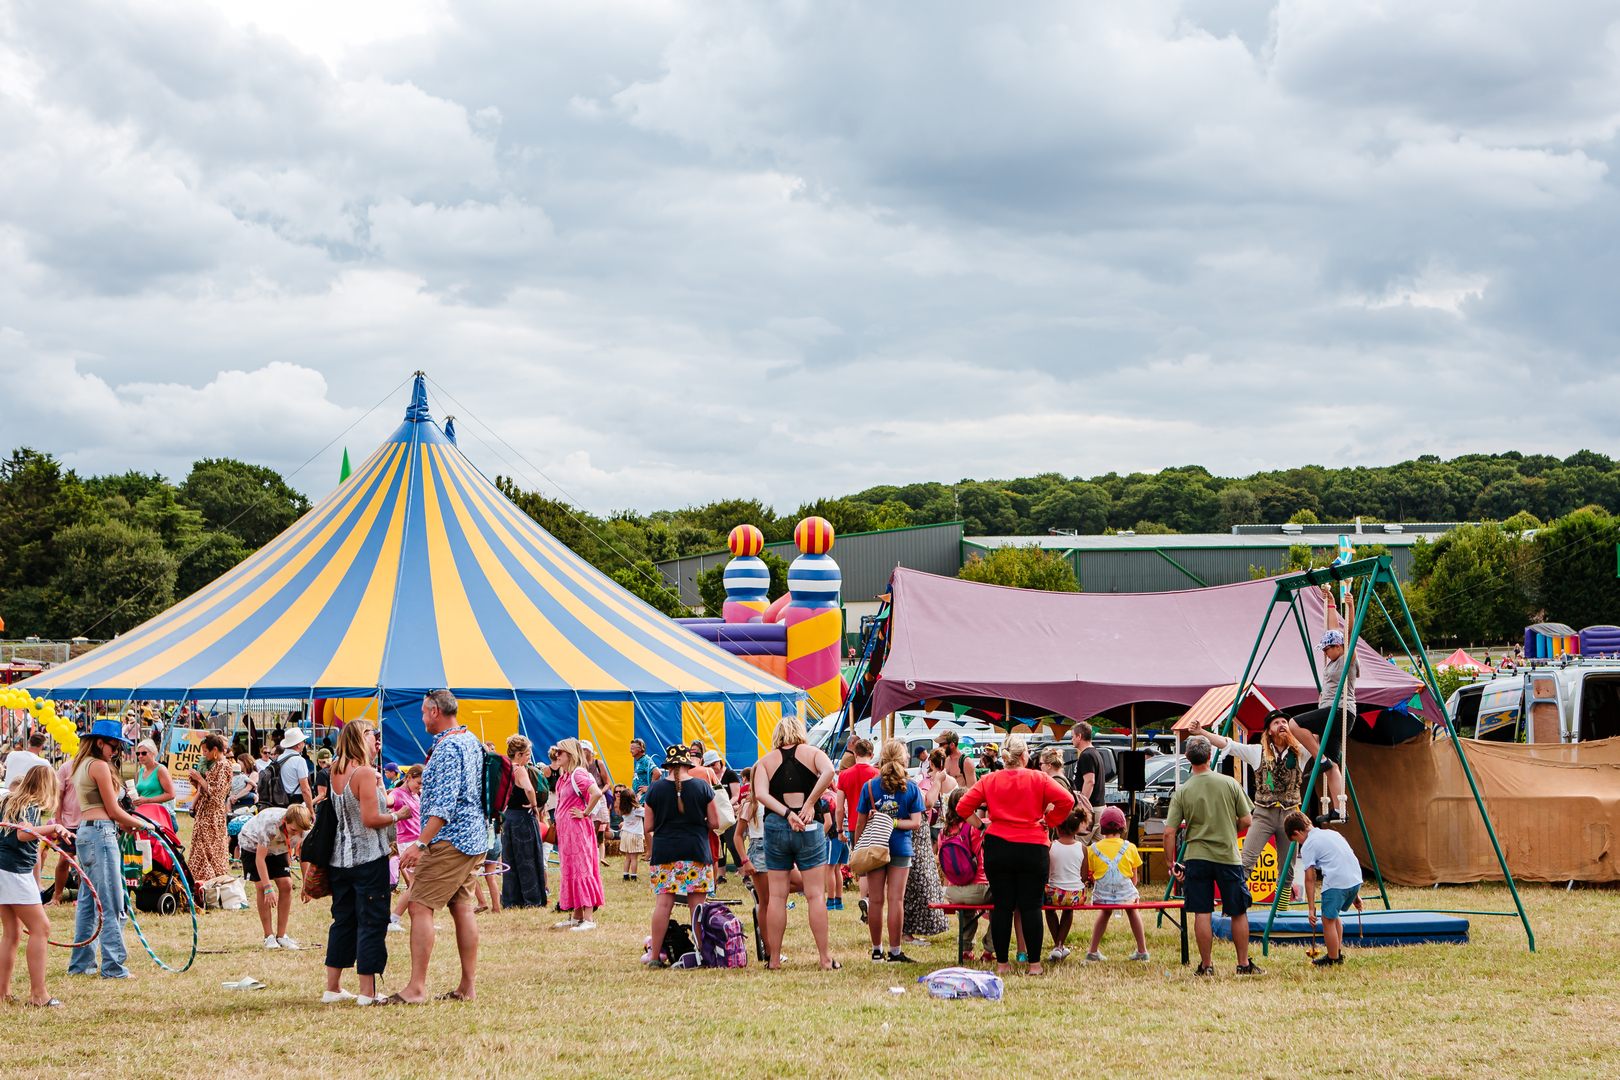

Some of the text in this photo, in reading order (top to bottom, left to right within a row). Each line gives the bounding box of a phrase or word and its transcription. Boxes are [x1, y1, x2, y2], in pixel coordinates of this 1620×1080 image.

[178, 743, 201, 753] WIN
[175, 752, 202, 763] THIS
[1249, 870, 1276, 882] GULL
[125, 879, 139, 887] an
[1249, 882, 1273, 893] JECT
